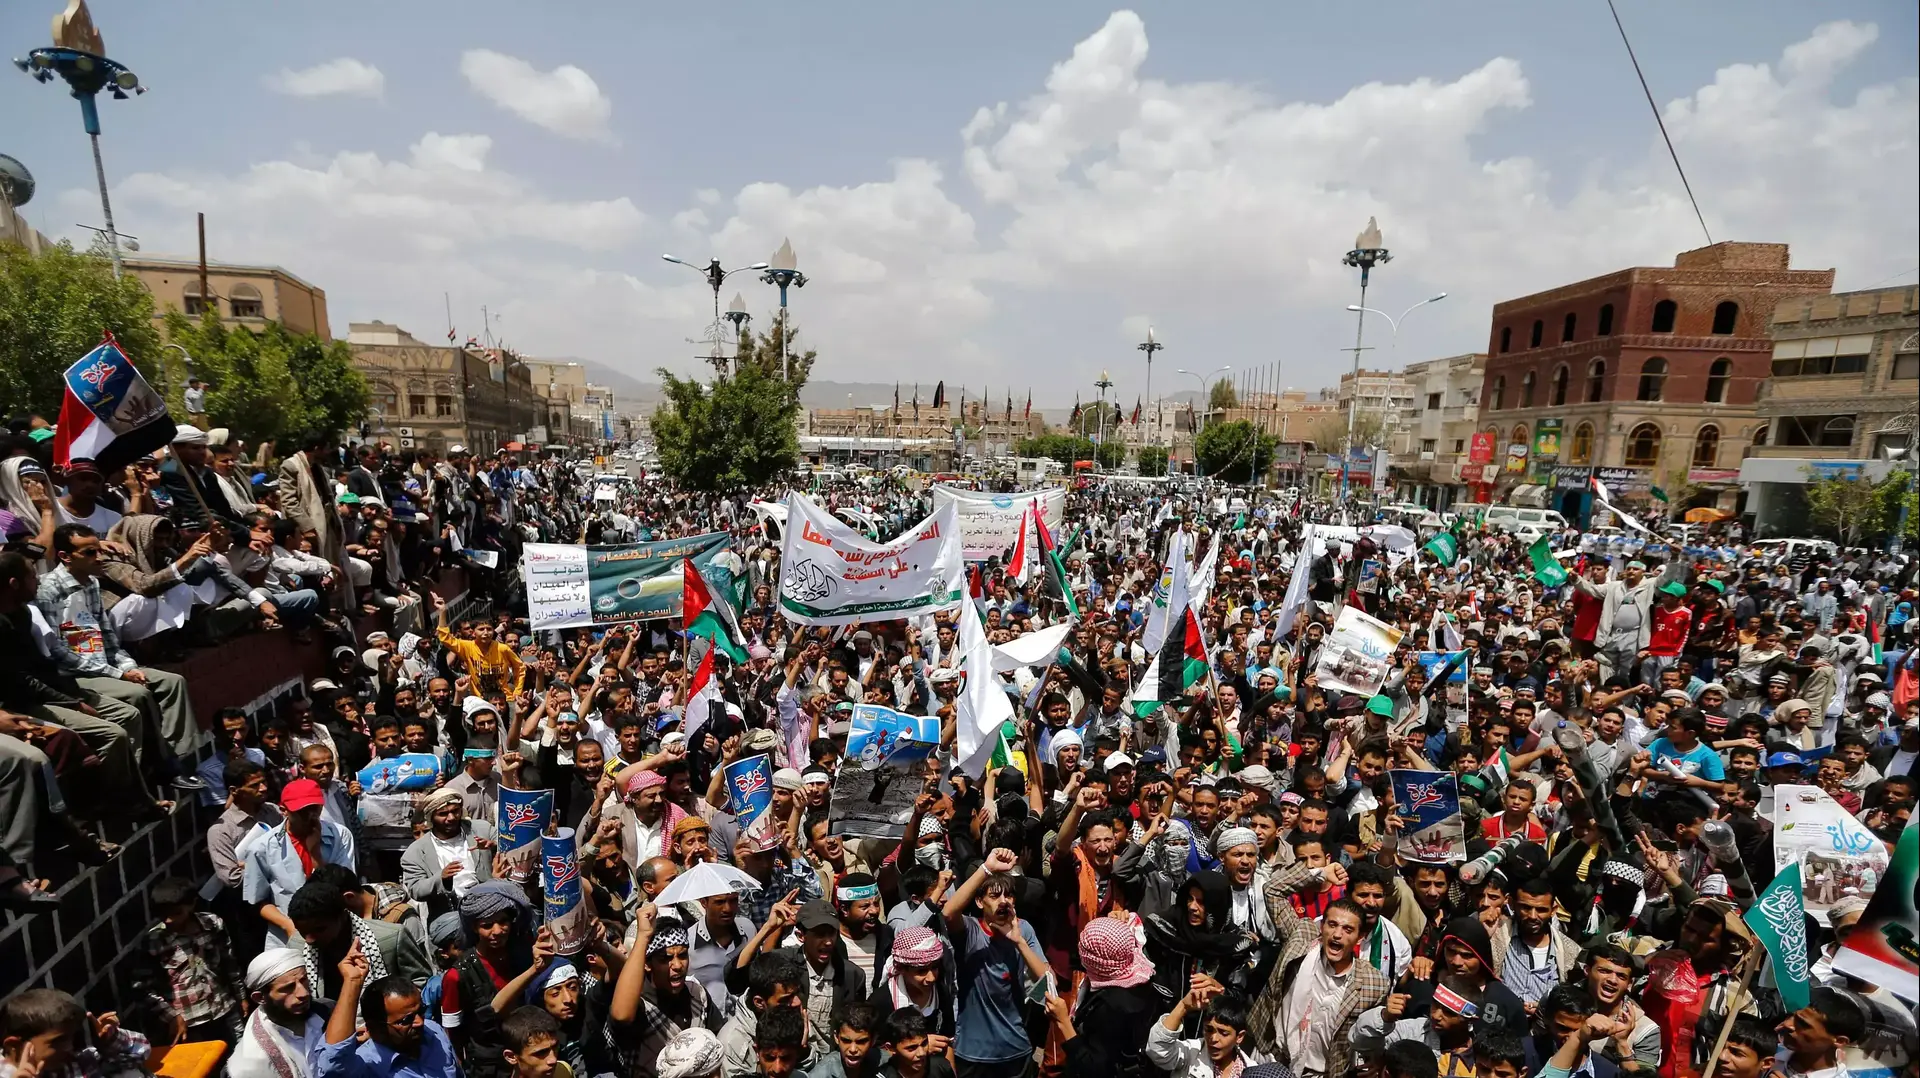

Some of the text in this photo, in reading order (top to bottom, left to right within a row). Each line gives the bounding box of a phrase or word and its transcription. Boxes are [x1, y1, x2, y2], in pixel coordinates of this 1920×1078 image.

[79, 360, 117, 393] غزة
[532, 579, 585, 591] في الميدان
[573, 593, 586, 603] ولا
[534, 608, 587, 620] على الجدران
[593, 611, 626, 623] الميدان
[629, 610, 645, 619] في
[735, 768, 770, 803] غزة
[1406, 783, 1443, 812] غزة
[505, 802, 540, 831] غزة
[736, 803, 755, 817] تنتص
[1824, 818, 1874, 856] حياة
[544, 893, 566, 906] تنتص
